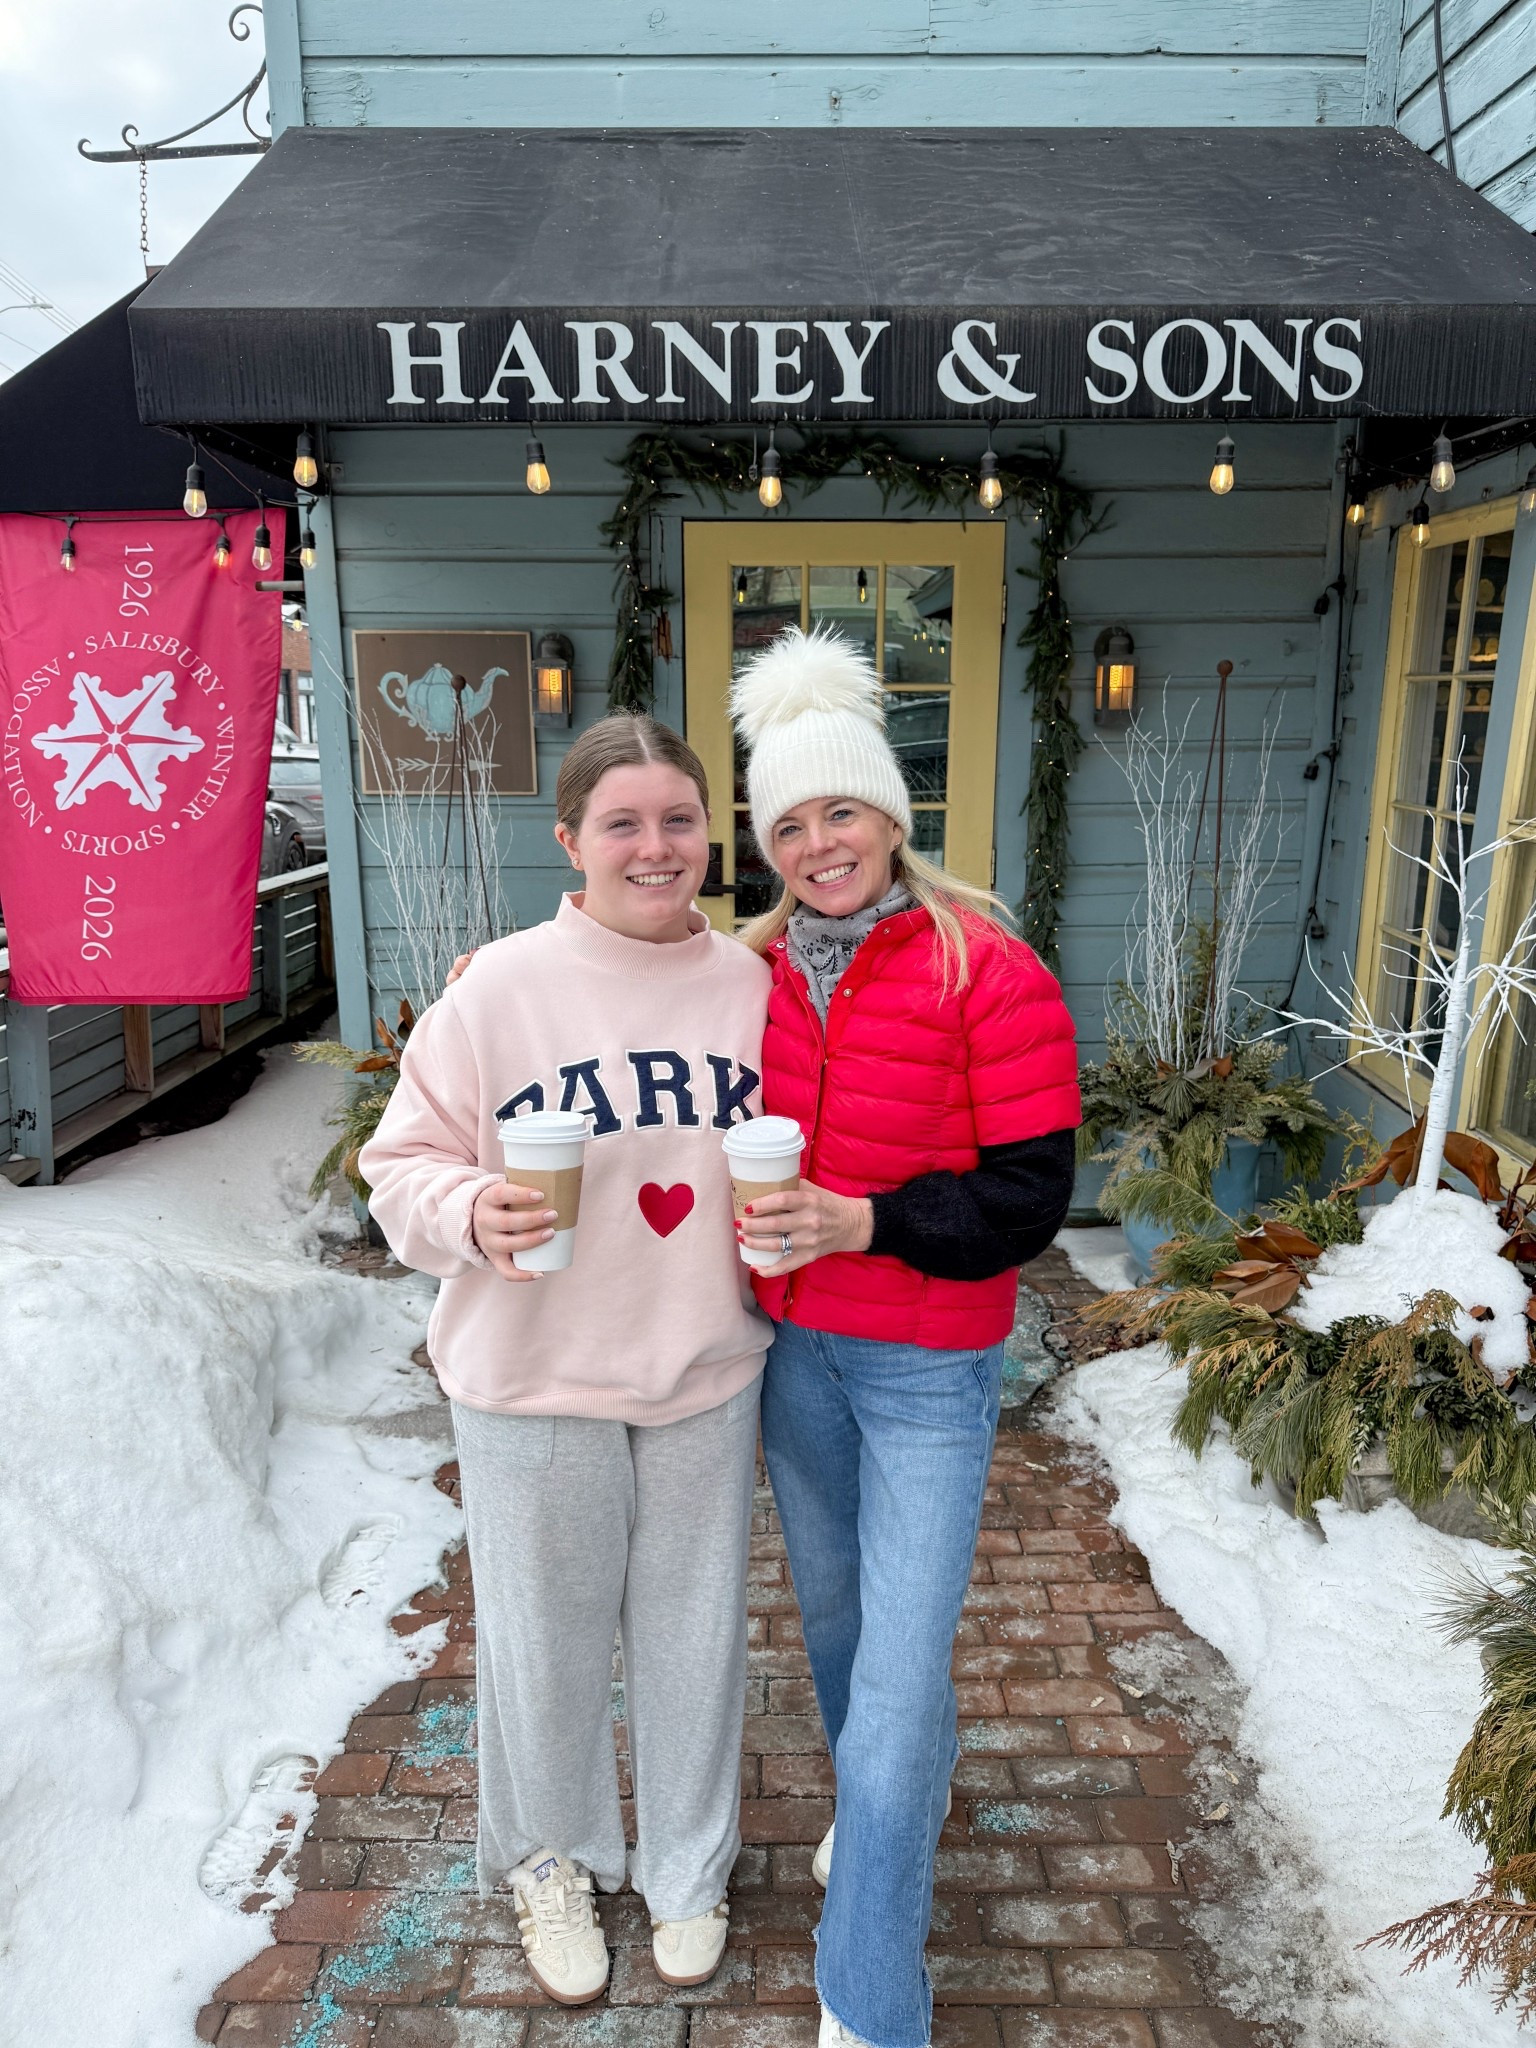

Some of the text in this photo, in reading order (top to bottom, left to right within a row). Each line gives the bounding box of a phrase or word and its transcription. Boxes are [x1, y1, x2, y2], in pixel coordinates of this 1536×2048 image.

[377, 318, 1364, 405] HARNEY & SONS
[119, 542, 154, 617] 1926
[4, 657, 62, 828] ASSOCIATION
[60, 631, 234, 857] SALISBURY WINTER SPORTS
[81, 874, 116, 961] 2026
